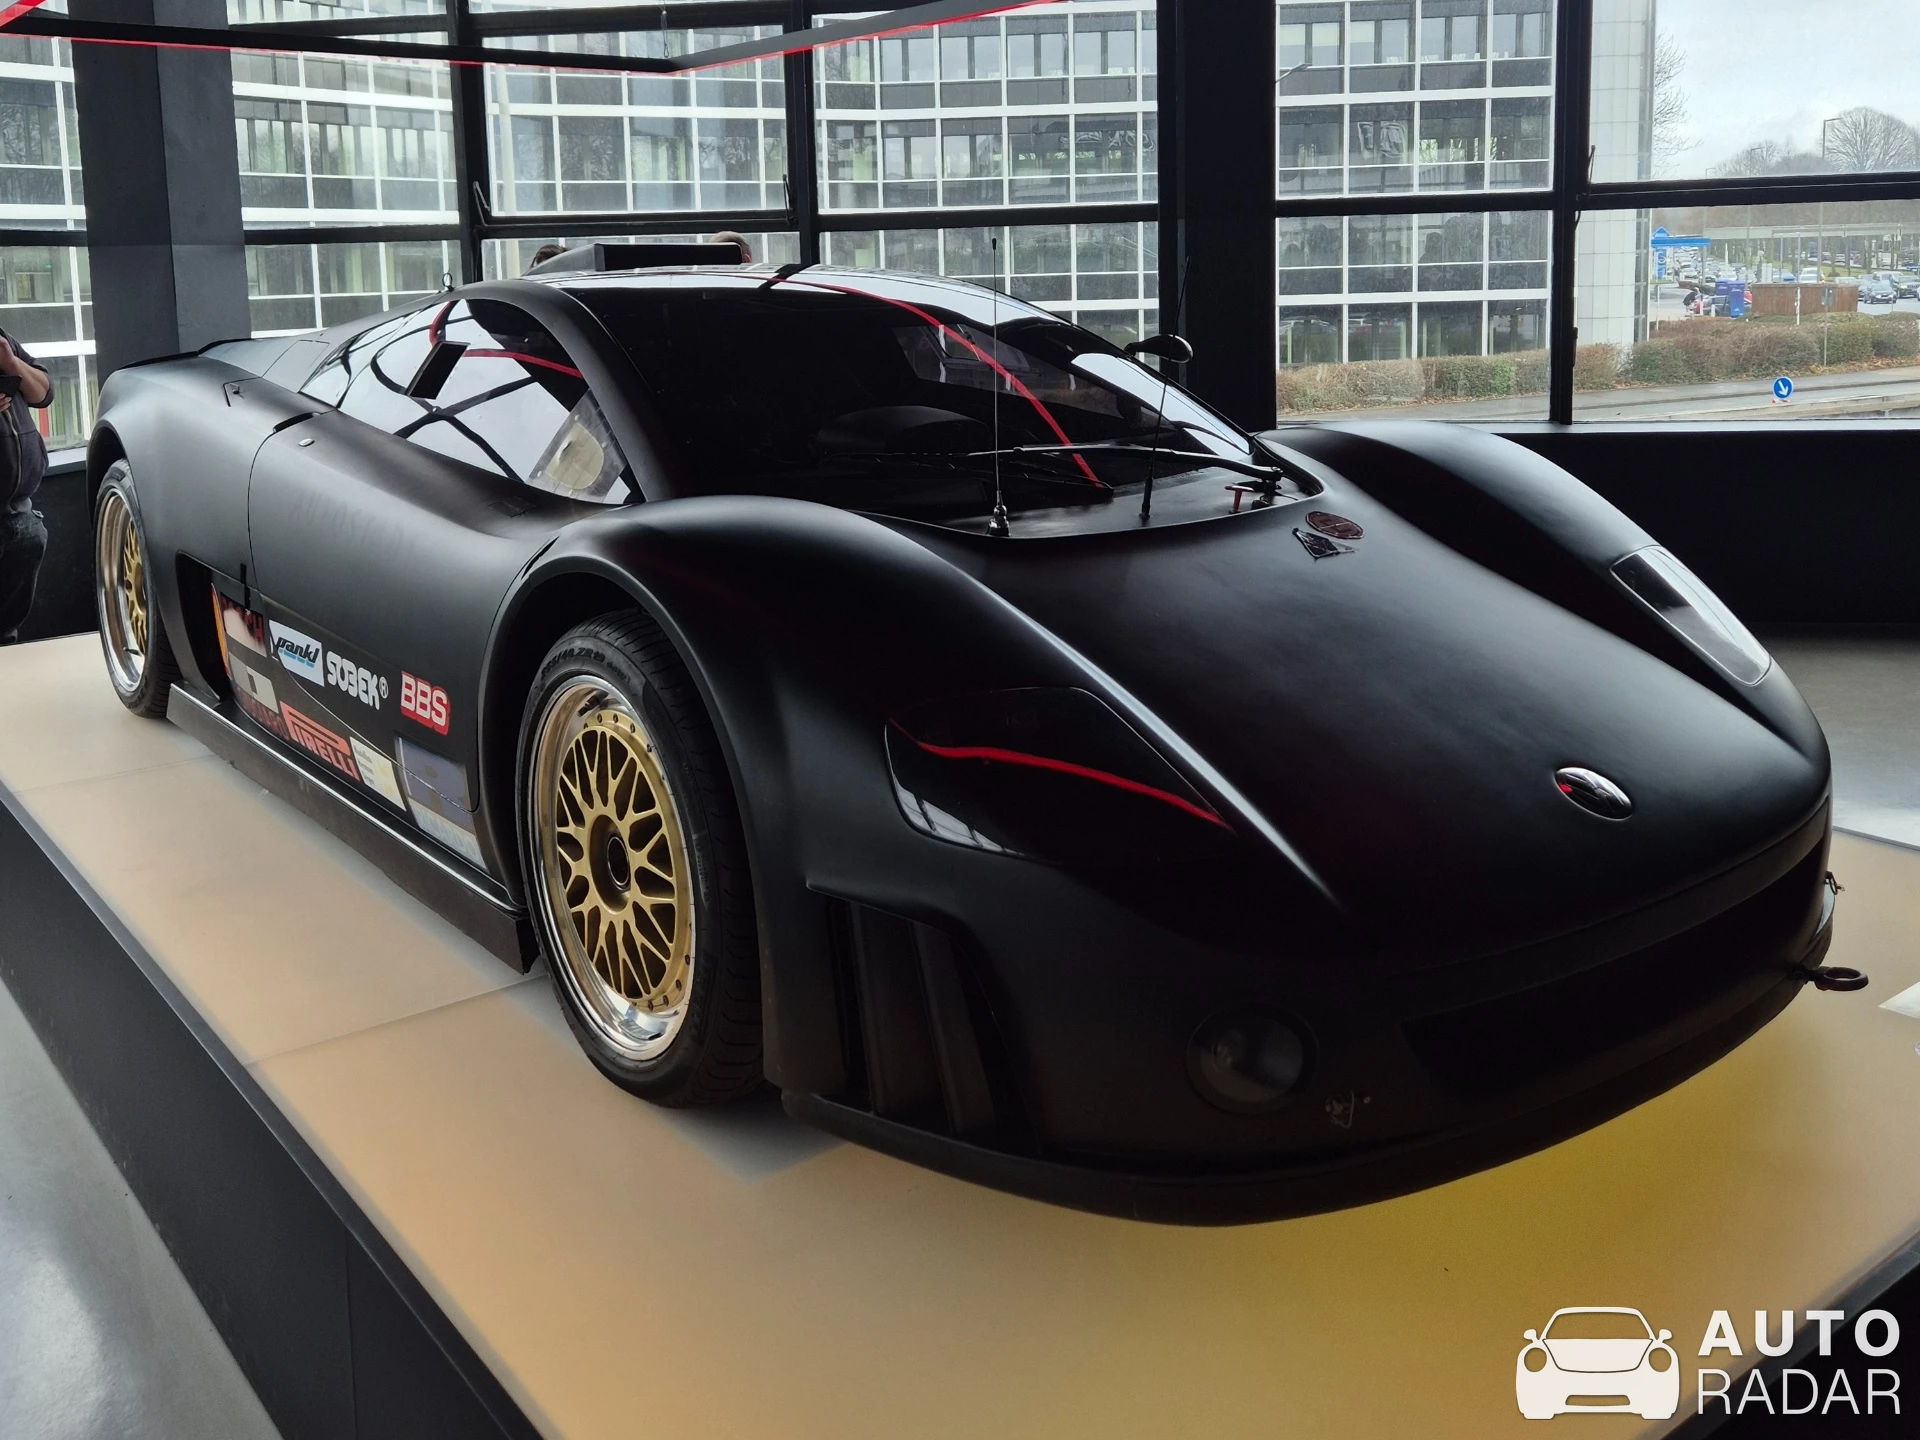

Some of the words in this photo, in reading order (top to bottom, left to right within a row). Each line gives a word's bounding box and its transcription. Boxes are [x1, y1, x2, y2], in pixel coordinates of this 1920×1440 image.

[276, 636, 320, 664] pankl
[401, 673, 448, 726] BBS
[280, 700, 360, 781] PIRELLI
